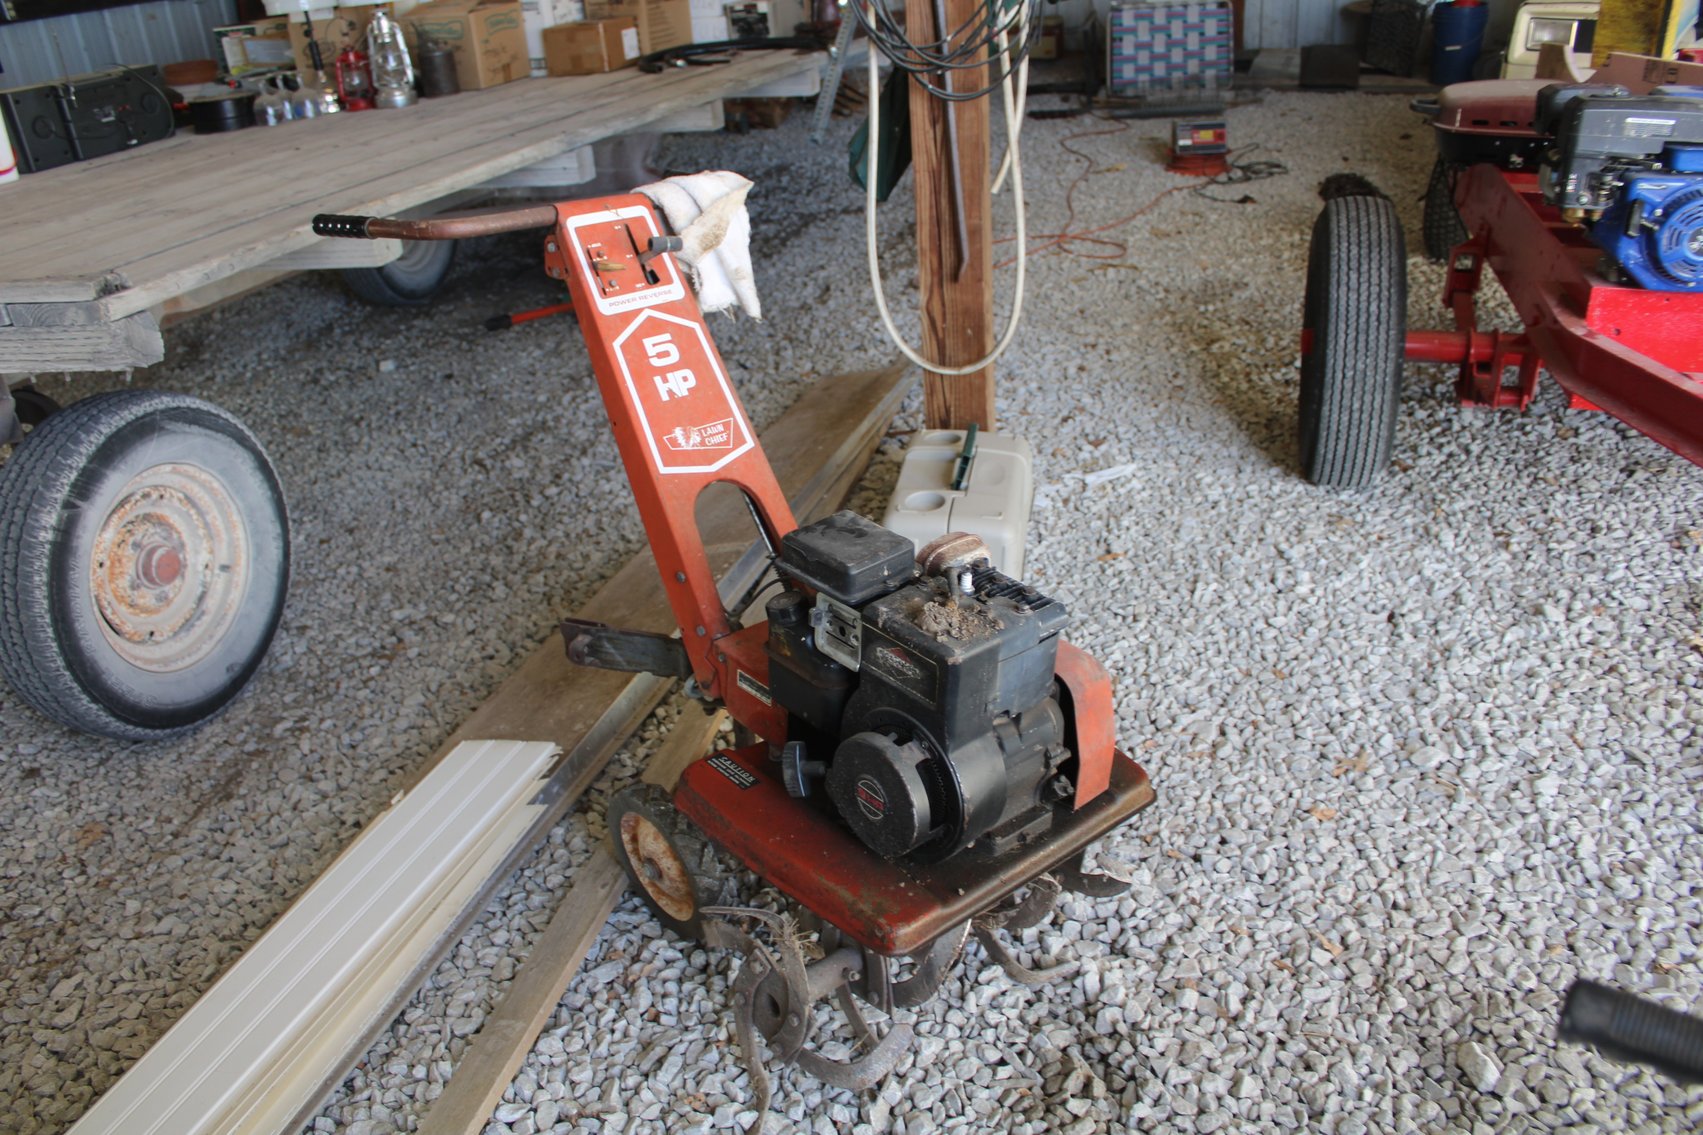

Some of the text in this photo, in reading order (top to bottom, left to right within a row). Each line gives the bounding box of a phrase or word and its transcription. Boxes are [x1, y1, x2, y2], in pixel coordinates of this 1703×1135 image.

[608, 289, 673, 308] POWER REVERSE
[642, 333, 680, 367] 5
[653, 369, 696, 401] HP
[701, 423, 724, 437] LAWN
[704, 432, 728, 446] CHIEF
[720, 756, 756, 782] CAUTION
